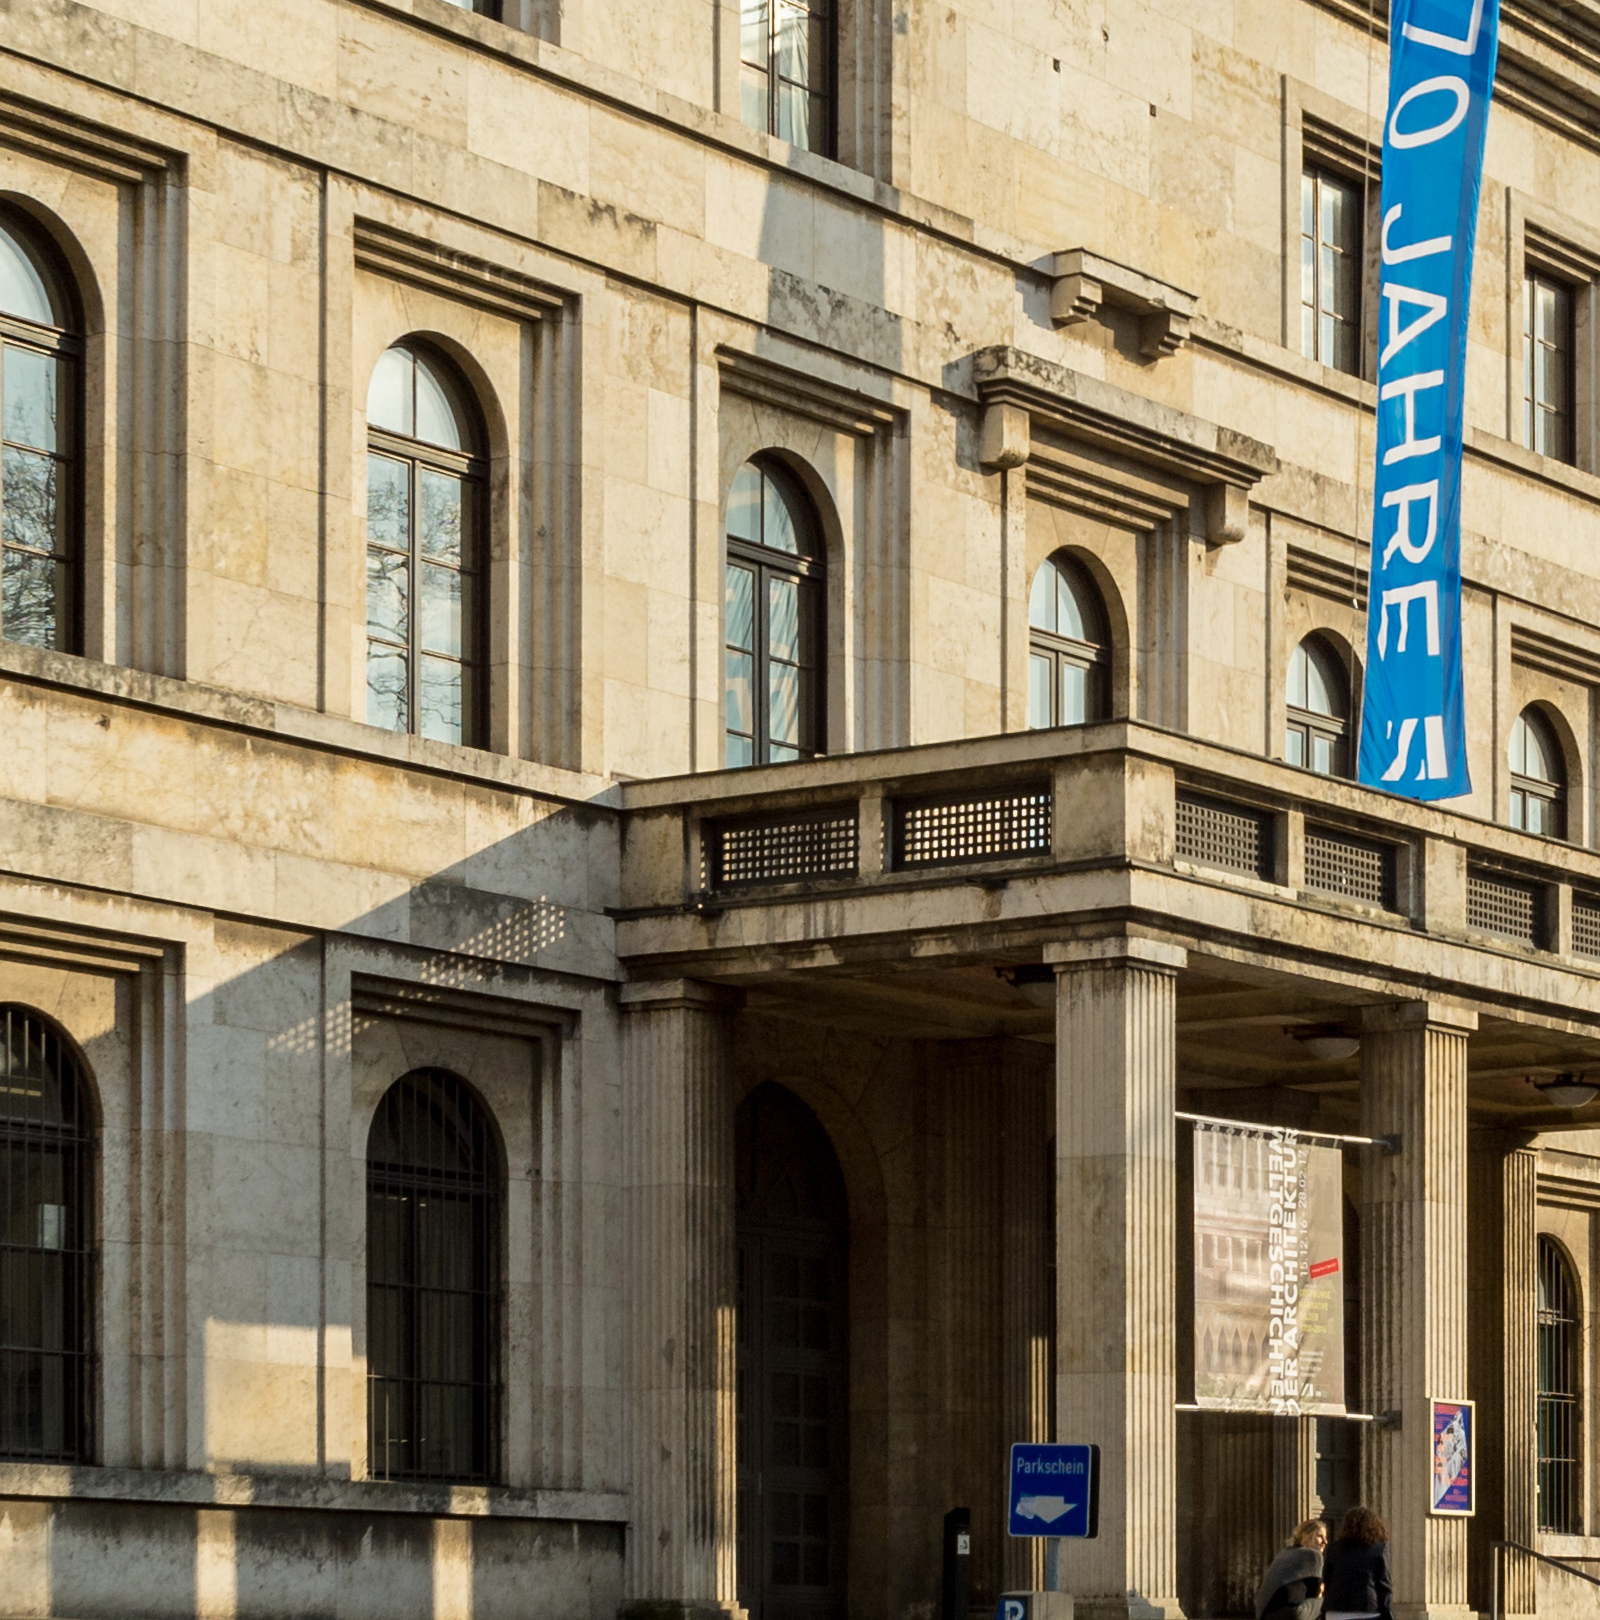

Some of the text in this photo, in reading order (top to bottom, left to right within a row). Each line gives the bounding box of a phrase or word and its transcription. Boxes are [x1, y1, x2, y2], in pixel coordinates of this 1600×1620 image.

[1379, 203, 1452, 659] JAHRE
[1298, 1149, 1308, 1209] 28.02.17
[1283, 1127, 1299, 1350] ARCHITEKTUR
[1016, 1455, 1084, 1475] Parkschein
[1004, 1600, 1025, 1620] P
